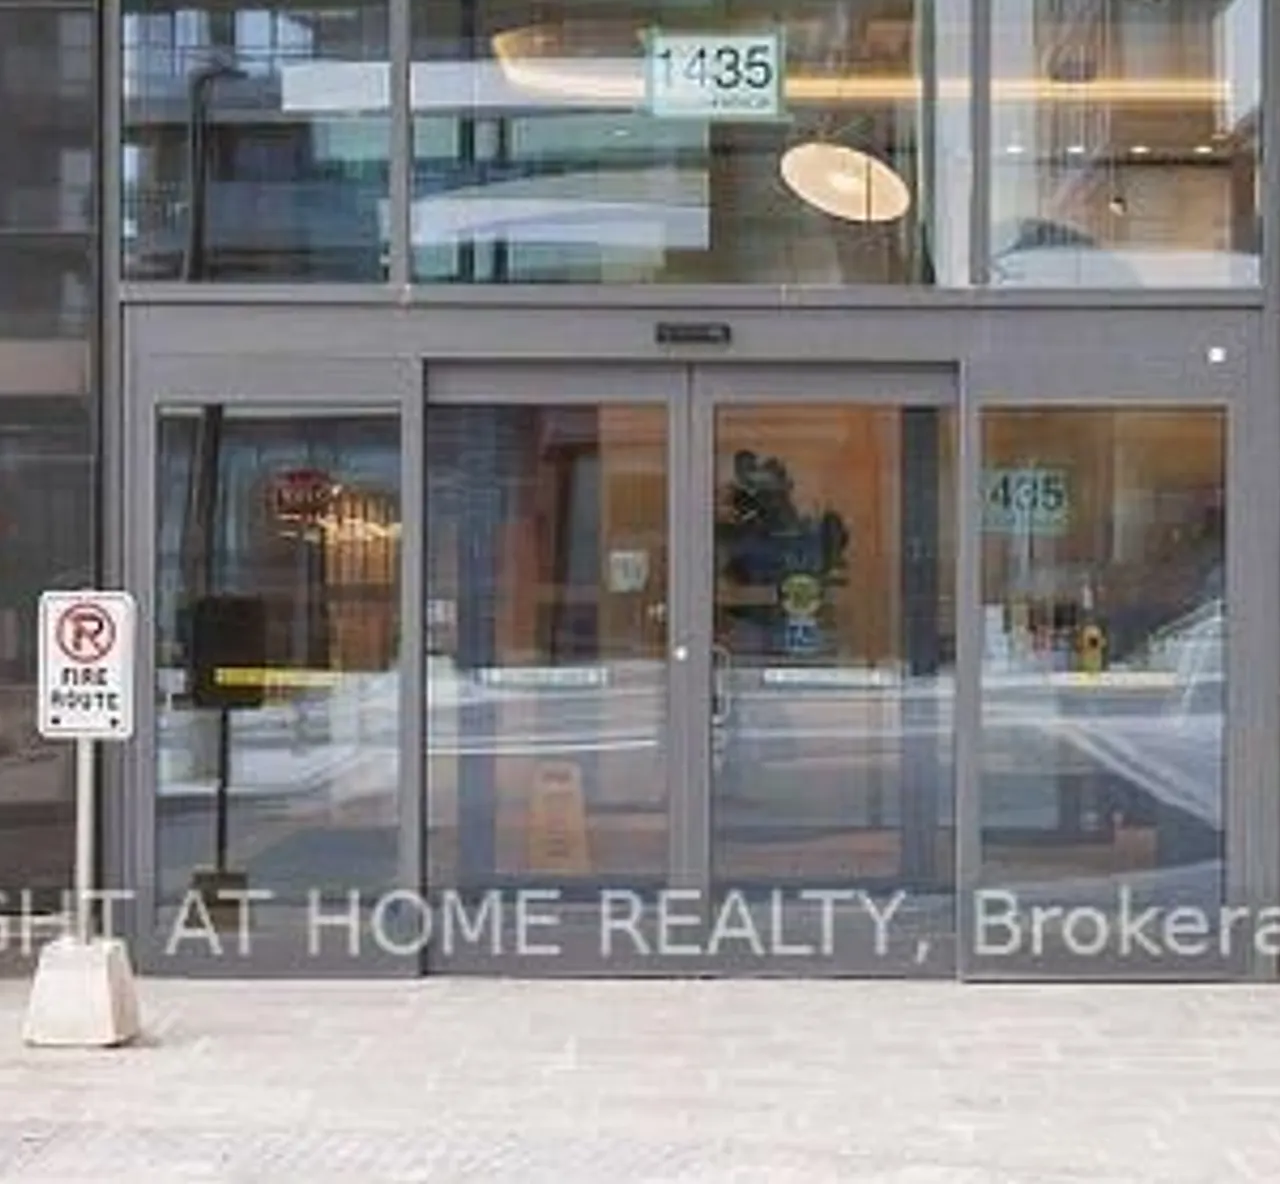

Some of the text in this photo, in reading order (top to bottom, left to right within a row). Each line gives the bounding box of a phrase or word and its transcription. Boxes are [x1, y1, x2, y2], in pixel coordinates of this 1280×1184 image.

[657, 44, 773, 90] 1435
[61, 667, 109, 686] FIRE
[51, 690, 120, 711] ROUTE
